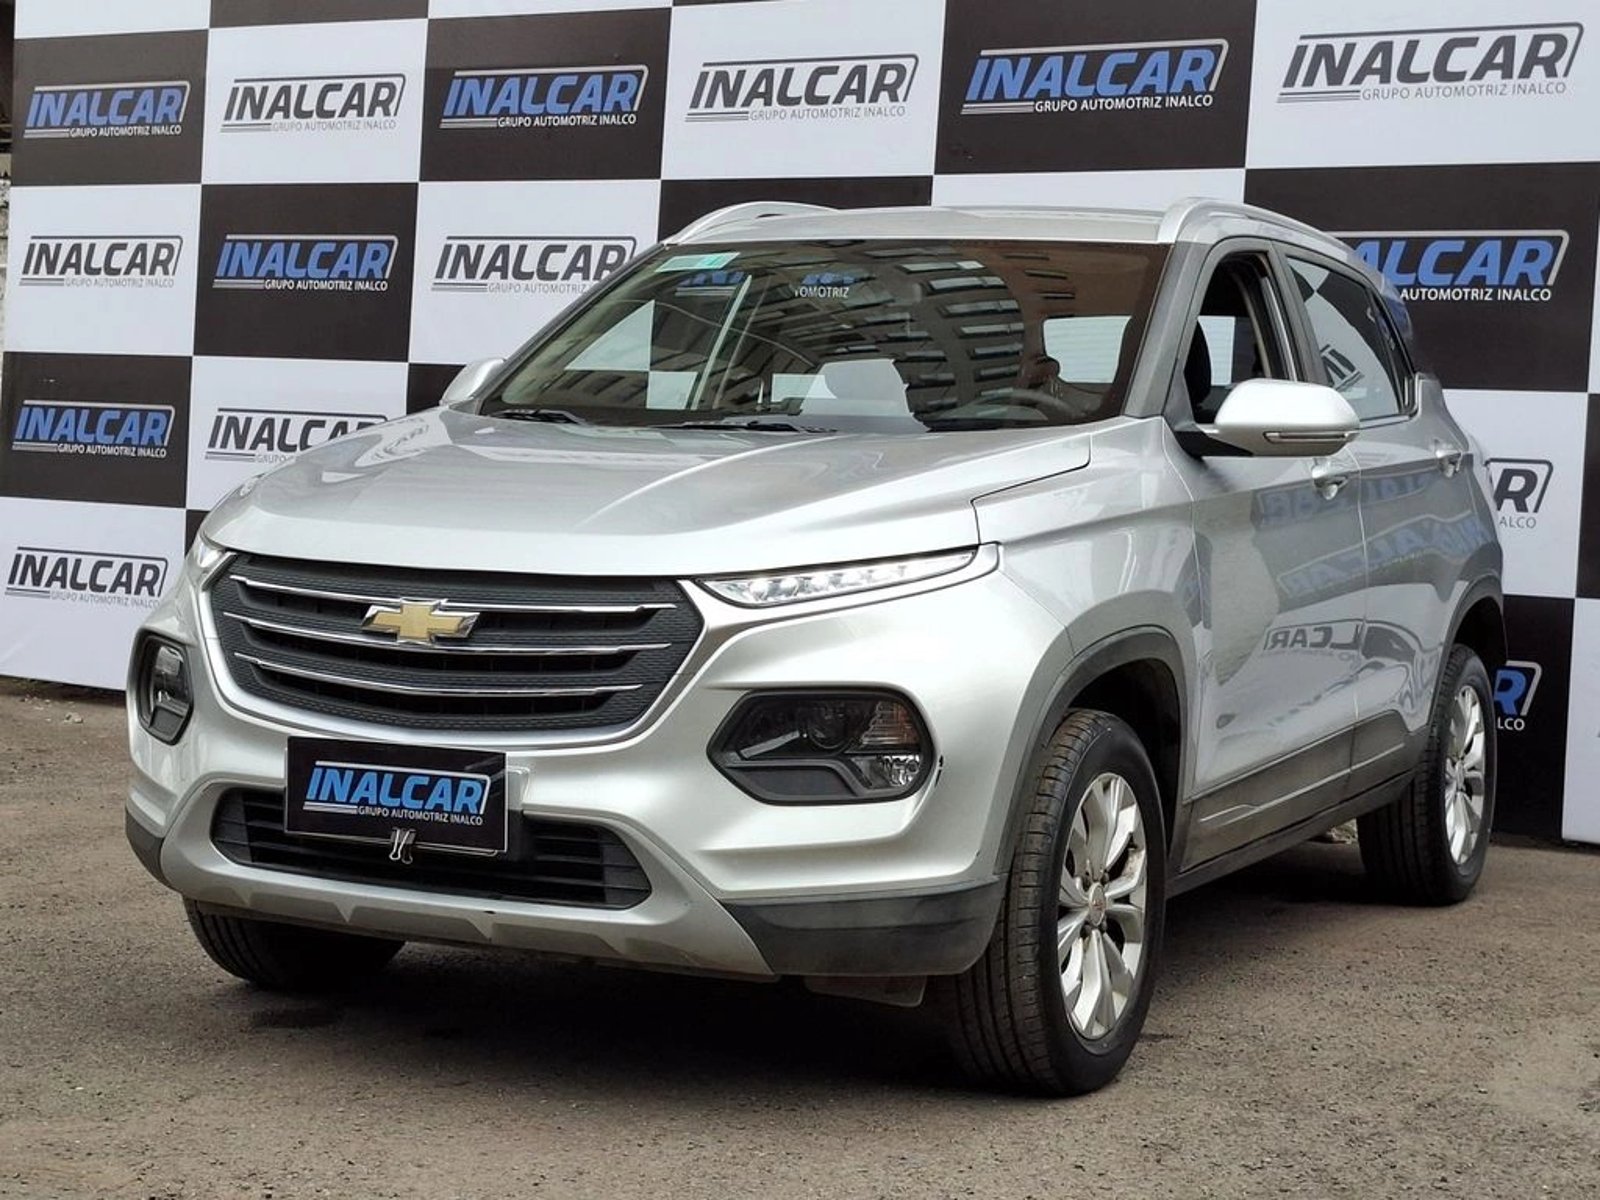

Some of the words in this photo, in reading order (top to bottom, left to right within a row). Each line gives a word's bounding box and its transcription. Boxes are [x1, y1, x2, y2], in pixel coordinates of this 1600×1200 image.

[1282, 34, 1568, 88] INALCAR
[966, 49, 1217, 101] INALCAR
[444, 73, 637, 116] INALCAR
[690, 64, 906, 109] INALCAR
[1362, 87, 1411, 101] GRUPO
[1414, 84, 1507, 100] AUTOMOTRIZ
[1510, 81, 1567, 95] INALCO
[26, 88, 186, 127] INALCAR
[224, 82, 400, 120] INALCAR
[1035, 100, 1078, 112] GRUPO
[1080, 97, 1162, 110] AUTOMOTRIZ
[1166, 95, 1212, 108] INALCO
[498, 116, 532, 128] GRUPO
[534, 115, 598, 127] AUTOMOTRIZ
[600, 114, 636, 125] INALCO
[750, 109, 787, 121] GRUPO
[789, 107, 861, 120] AUTOMOTRIZ
[864, 106, 905, 118] INALCO
[69, 127, 98, 137] GRUPO
[99, 126, 150, 137] AUTOMOTRIZ
[151, 125, 181, 136] INALCO
[273, 121, 301, 132] GRUPO
[303, 121, 360, 131] AUTOMOTRIZ
[362, 120, 396, 130] INALCO
[22, 242, 177, 276] INALCAR
[216, 242, 391, 279] INALCAR
[435, 244, 626, 281] INALCAR
[1354, 239, 1554, 286] ALCAR
[65, 277, 91, 287] GRUPO
[93, 277, 144, 287] AUTOMOTRIZ
[145, 278, 174, 288] INALCO
[265, 279, 294, 290] GRUPO
[296, 279, 352, 291] AUTOMOTRIZ
[355, 280, 388, 291] INALCO
[489, 283, 520, 293] GRUPO
[524, 284, 585, 294] AUTOMOTRIZ
[796, 286, 849, 298] OMOTRIZ
[1400, 288, 1493, 300] AUTOMOTRIZ
[1498, 288, 1551, 301] INALCO
[15, 406, 170, 446] INALCAR
[57, 443, 85, 455] GRUPO
[86, 444, 136, 457] AUTOMOTRIZ
[138, 447, 167, 459] INALCO
[1499, 516, 1537, 529] ALCO
[8, 554, 160, 597] INALCAR
[1497, 717, 1525, 731] LCO
[306, 767, 483, 815] INALCAR
[359, 807, 389, 817] GRUPO
[391, 809, 449, 823] AUTOMOTRIZ
[450, 814, 483, 826] INALCO
